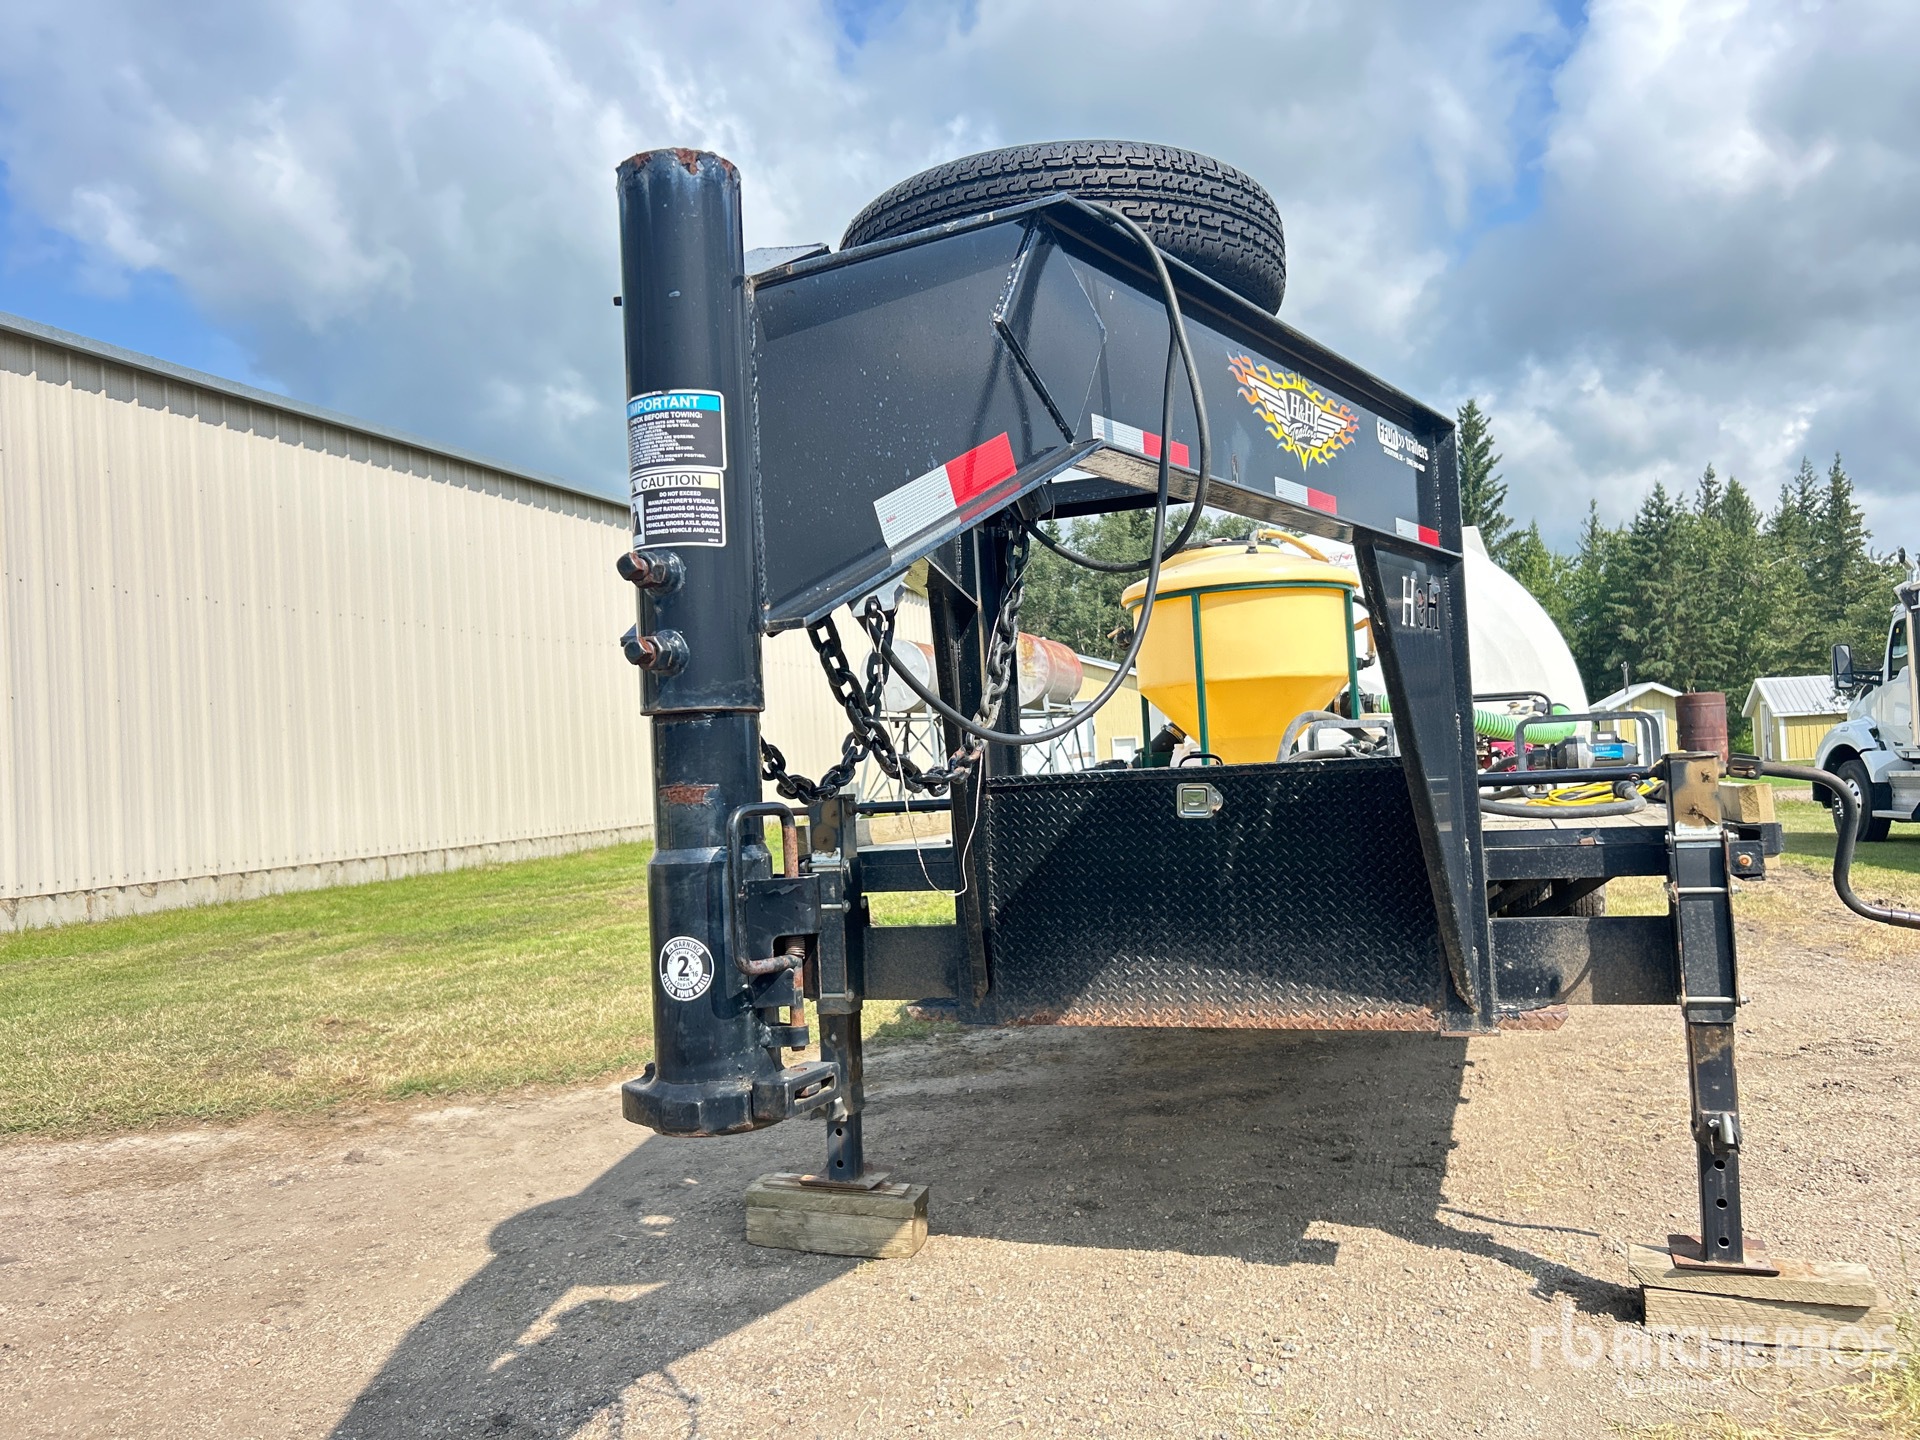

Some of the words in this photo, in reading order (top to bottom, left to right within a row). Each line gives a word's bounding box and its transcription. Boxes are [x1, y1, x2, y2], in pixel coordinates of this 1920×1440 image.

[631, 396, 700, 414] IMPORTANT
[1289, 392, 1315, 426] H&H
[644, 412, 669, 420] BEFORE
[641, 474, 702, 490] CAUTION
[674, 941, 702, 953] WARNING
[678, 956, 689, 977] 2
[677, 989, 694, 997] YOUR
